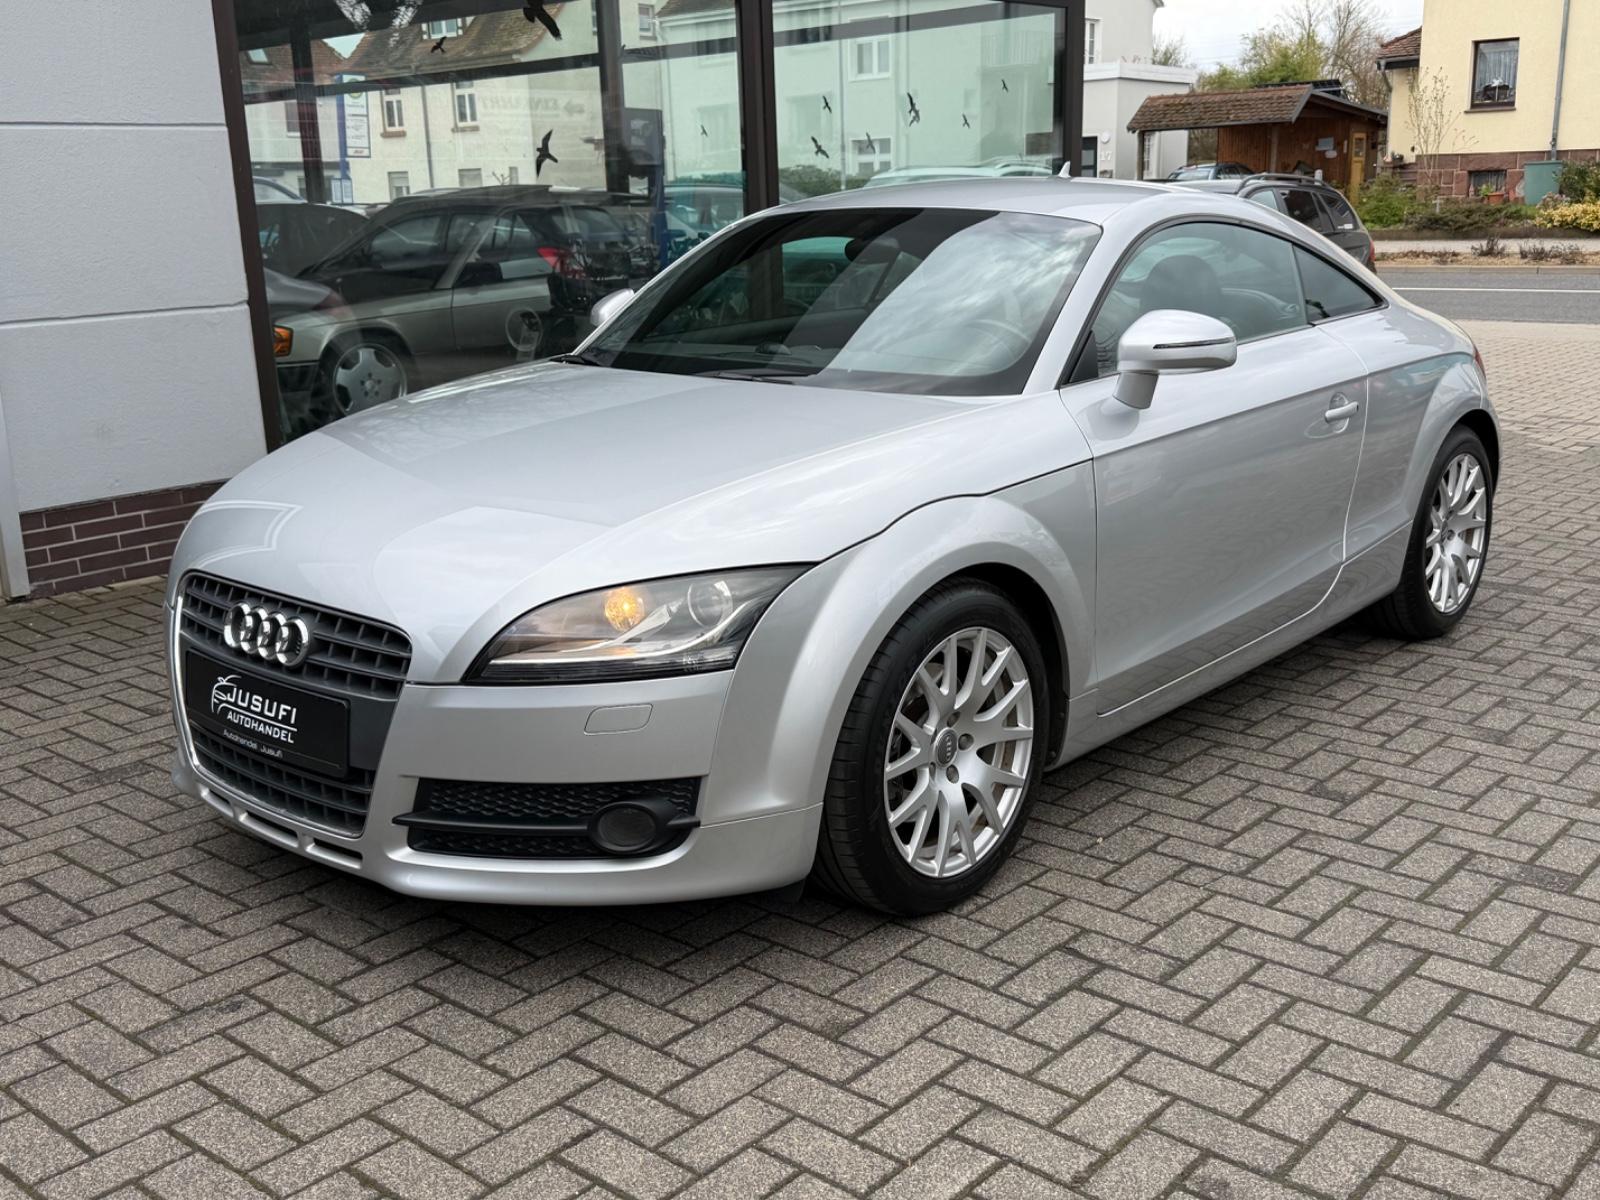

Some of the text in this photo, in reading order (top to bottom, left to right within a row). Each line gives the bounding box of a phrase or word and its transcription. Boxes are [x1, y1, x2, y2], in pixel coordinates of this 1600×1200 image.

[1100, 151, 1113, 161] 17
[227, 688, 296, 724] JUSUFI
[226, 711, 294, 744] AUTOHANDEL
